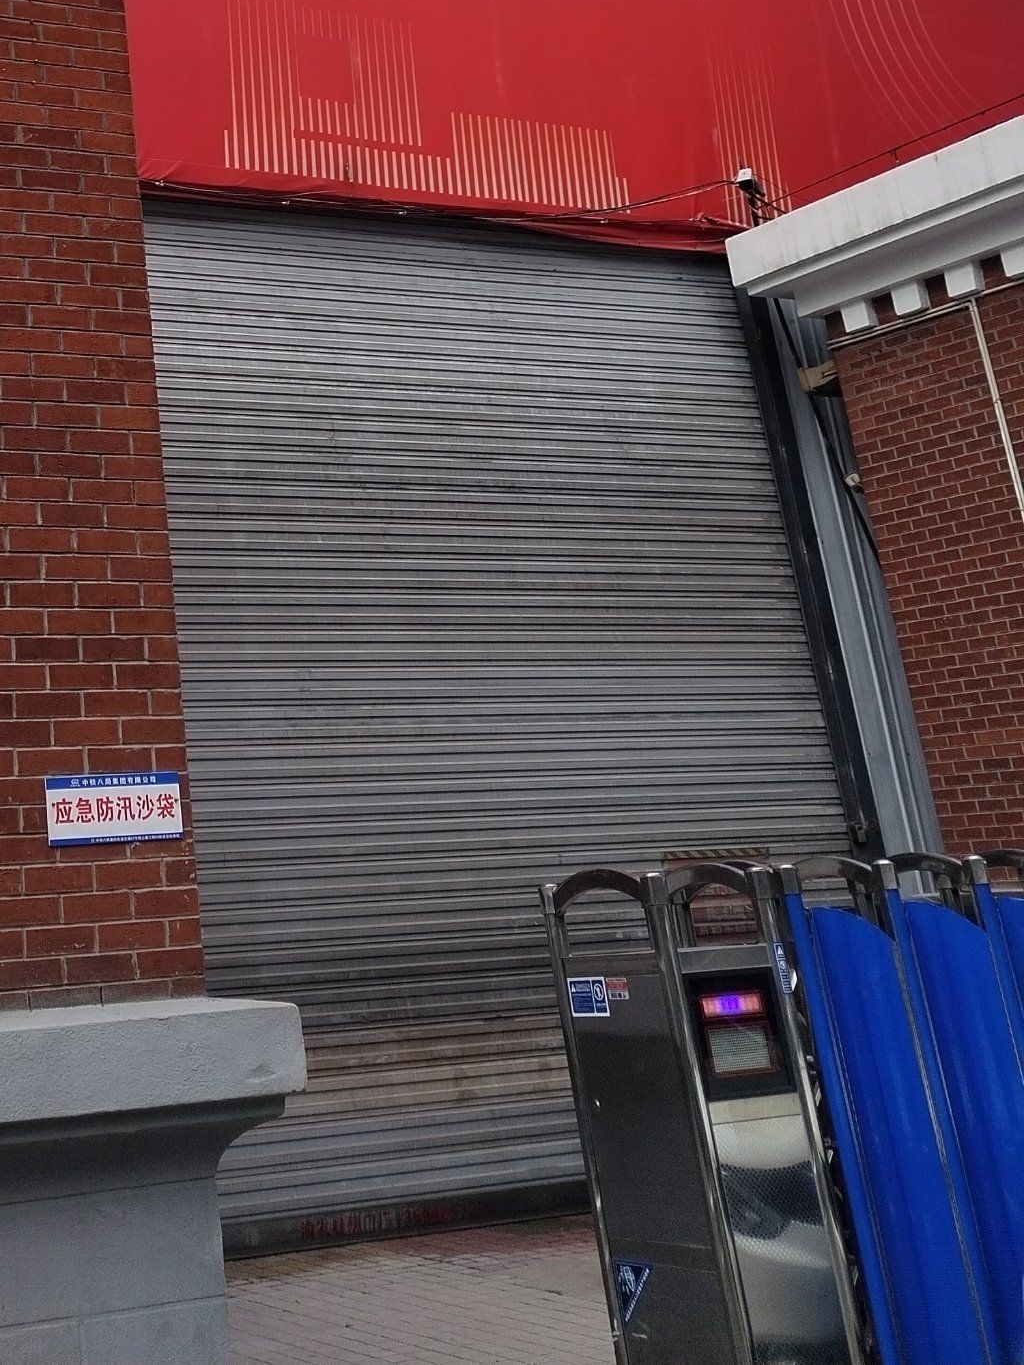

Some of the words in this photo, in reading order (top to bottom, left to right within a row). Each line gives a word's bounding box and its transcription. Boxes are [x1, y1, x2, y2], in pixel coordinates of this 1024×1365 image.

[54, 793, 176, 824] 应急防汛沙袋
